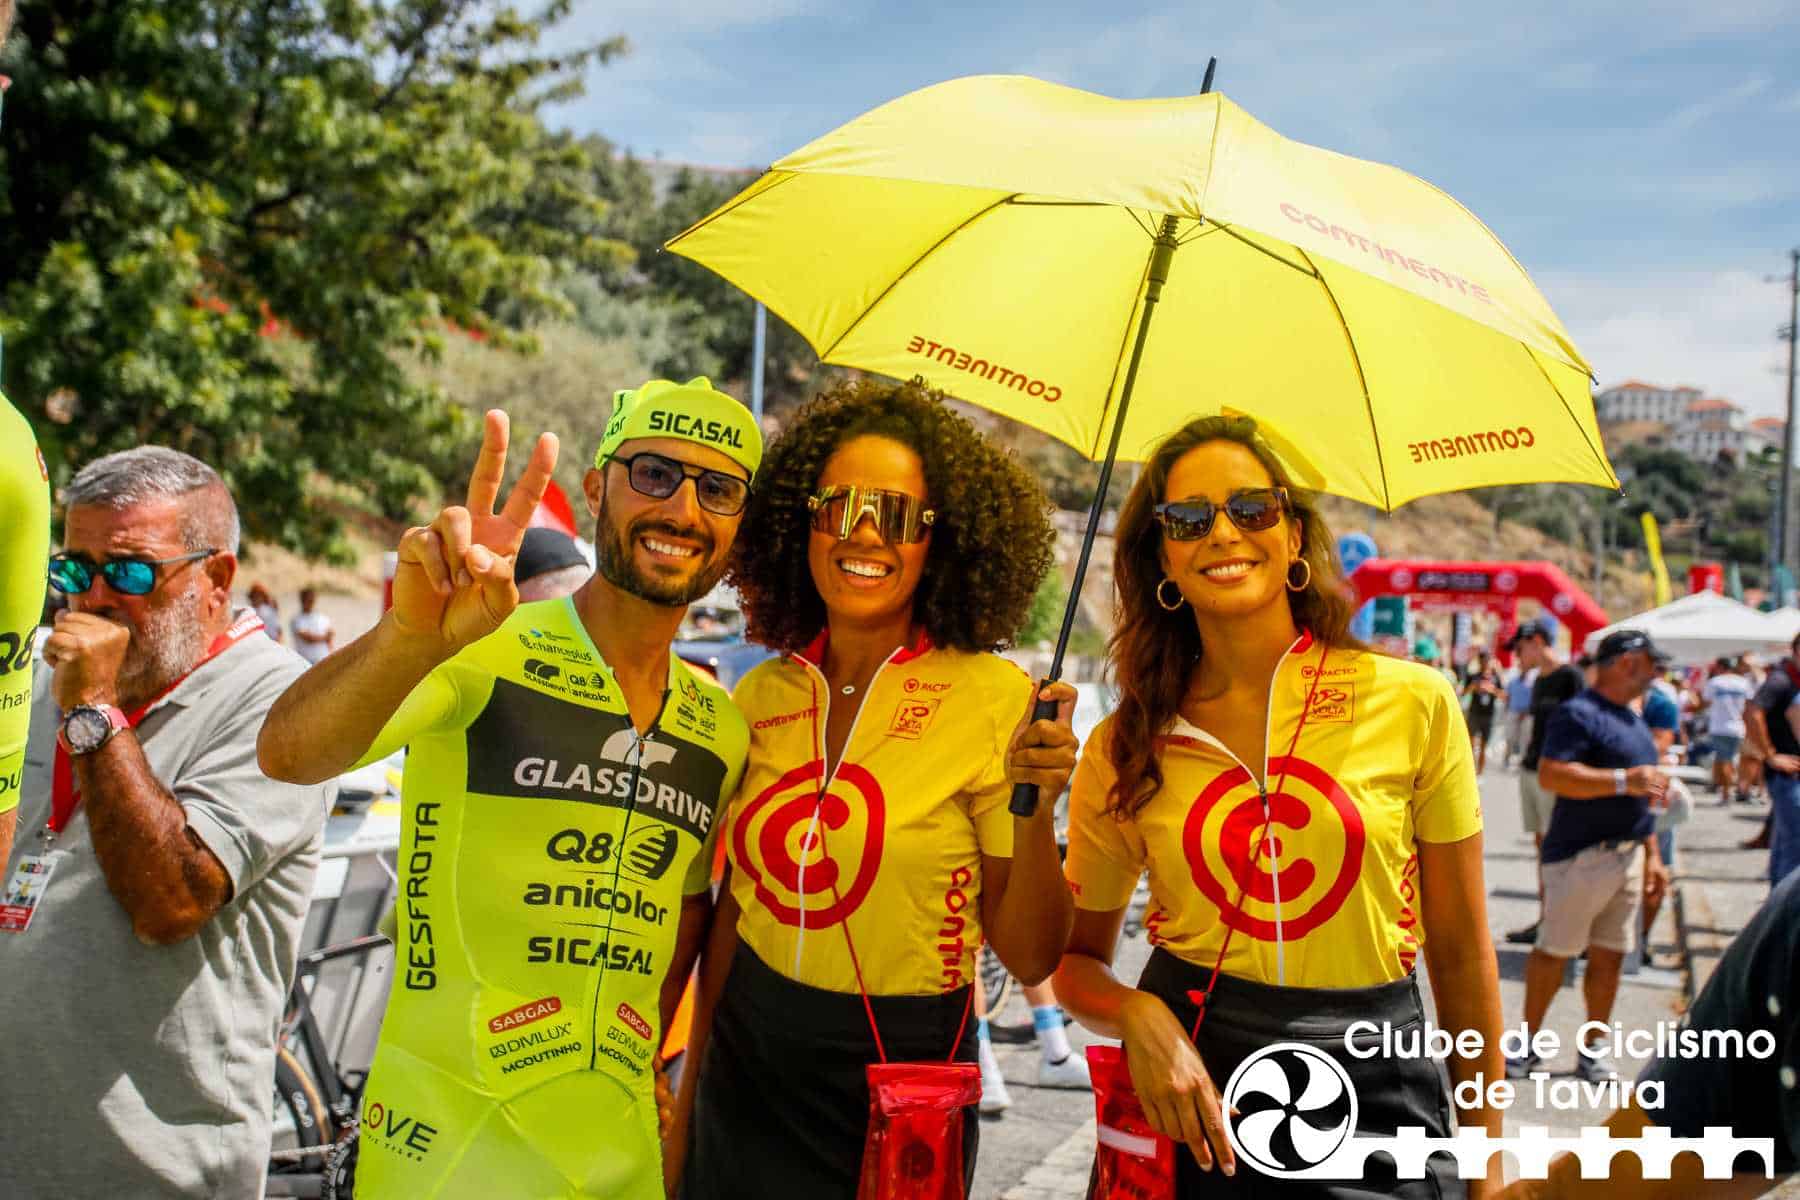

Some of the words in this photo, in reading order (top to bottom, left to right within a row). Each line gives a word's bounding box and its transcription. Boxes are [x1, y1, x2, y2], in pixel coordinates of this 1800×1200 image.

[1280, 203, 1492, 304] CONTINENTE
[649, 411, 743, 448] SICASAL
[572, 688, 611, 703] anicolor
[514, 757, 713, 833] GLASSDRIVE
[547, 828, 614, 864] Q8
[406, 802, 440, 990] GESFROTA
[523, 879, 668, 926] anicolor
[528, 936, 653, 975] SICASAL
[492, 1001, 557, 1031] SABGAL
[618, 1005, 650, 1037] SABGAL
[502, 1041, 582, 1074] MCOUTINHO
[362, 1096, 438, 1153] LOVE
